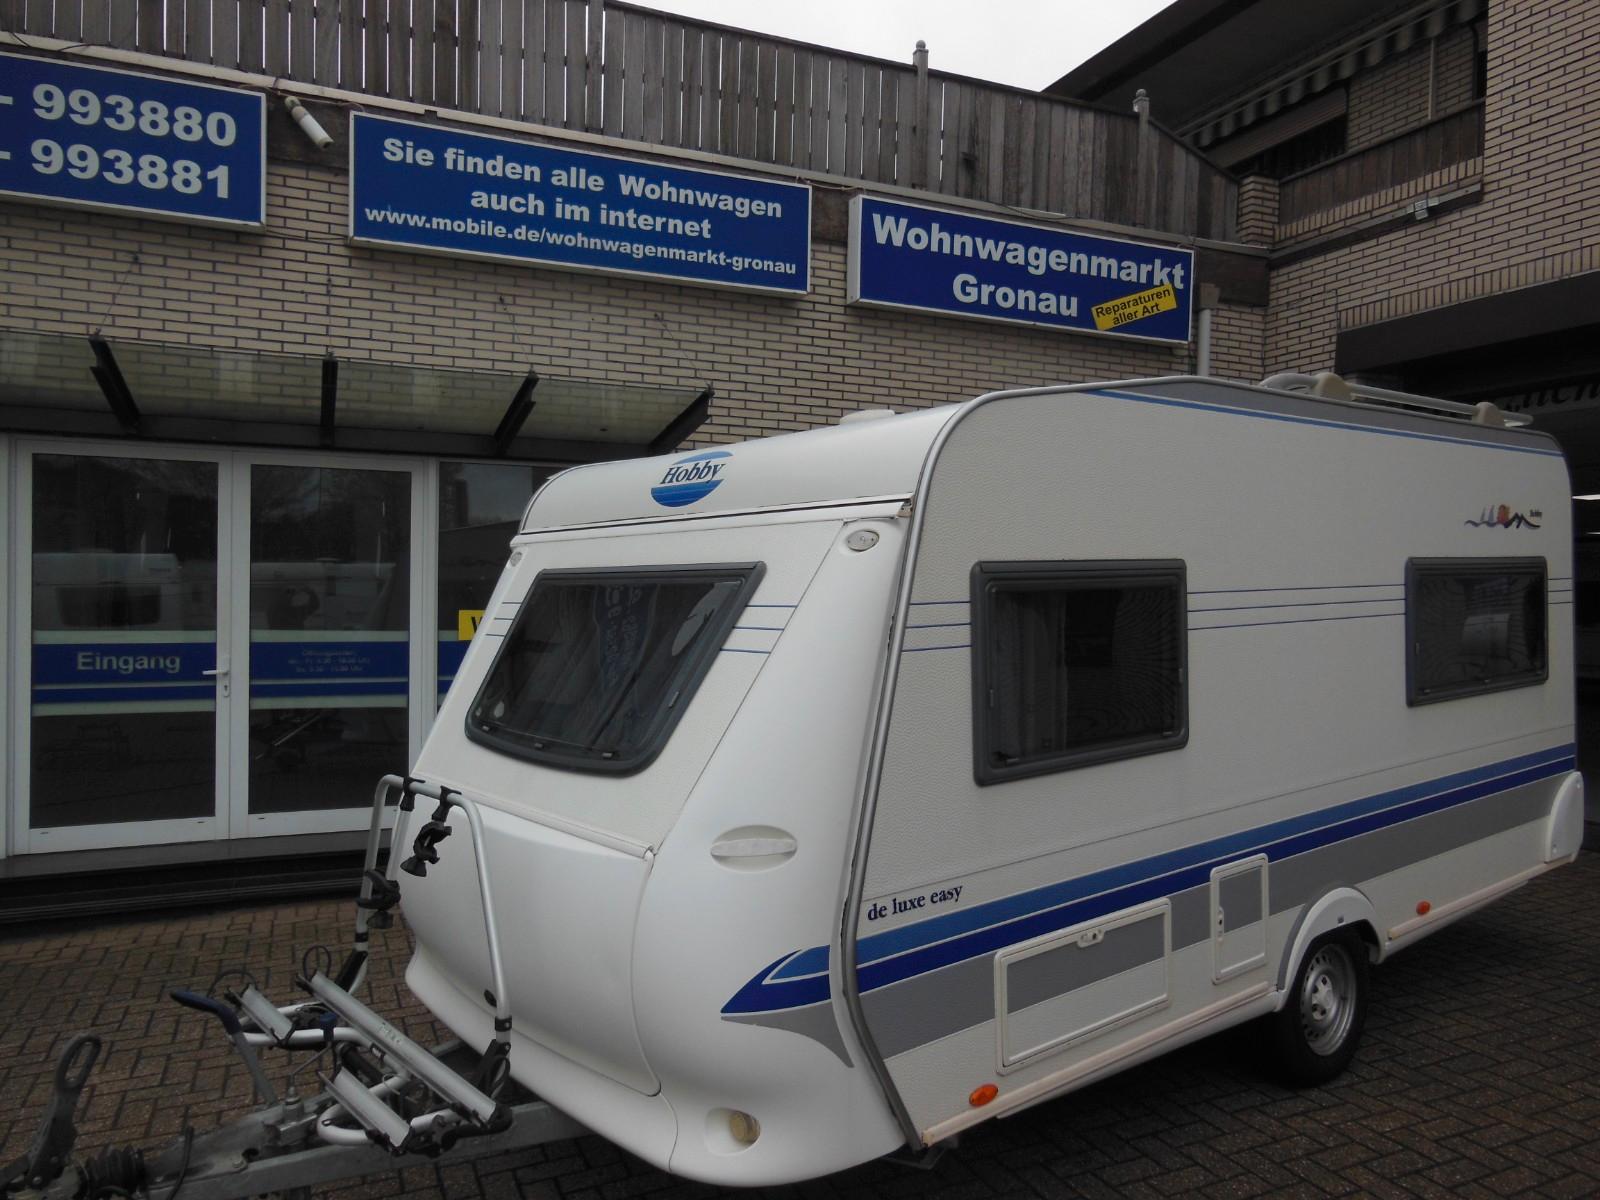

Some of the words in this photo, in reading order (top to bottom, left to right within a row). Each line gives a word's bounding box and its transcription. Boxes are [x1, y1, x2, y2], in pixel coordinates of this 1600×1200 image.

[33, 84, 237, 147] 993880
[31, 139, 229, 199] 993881
[383, 138, 434, 166] Sie
[444, 148, 541, 182] finden
[551, 167, 605, 191] alle
[619, 174, 782, 218] Wohnwagen
[470, 189, 545, 215] auch
[555, 197, 590, 222] im
[600, 204, 712, 239] internet
[365, 208, 796, 275] www.mobile.de/wohnwagenmarkt-gronau
[872, 212, 1185, 290] Wohnwagenmarkt
[952, 273, 1078, 318] Gronau
[1095, 288, 1171, 318] Reparaturen
[1113, 309, 1138, 325] aller
[1141, 302, 1160, 316] Art
[660, 460, 726, 484] Hobby
[76, 651, 181, 675] Eingang
[867, 902, 888, 921] de
[892, 895, 926, 915] luxe
[930, 885, 963, 904] easy
